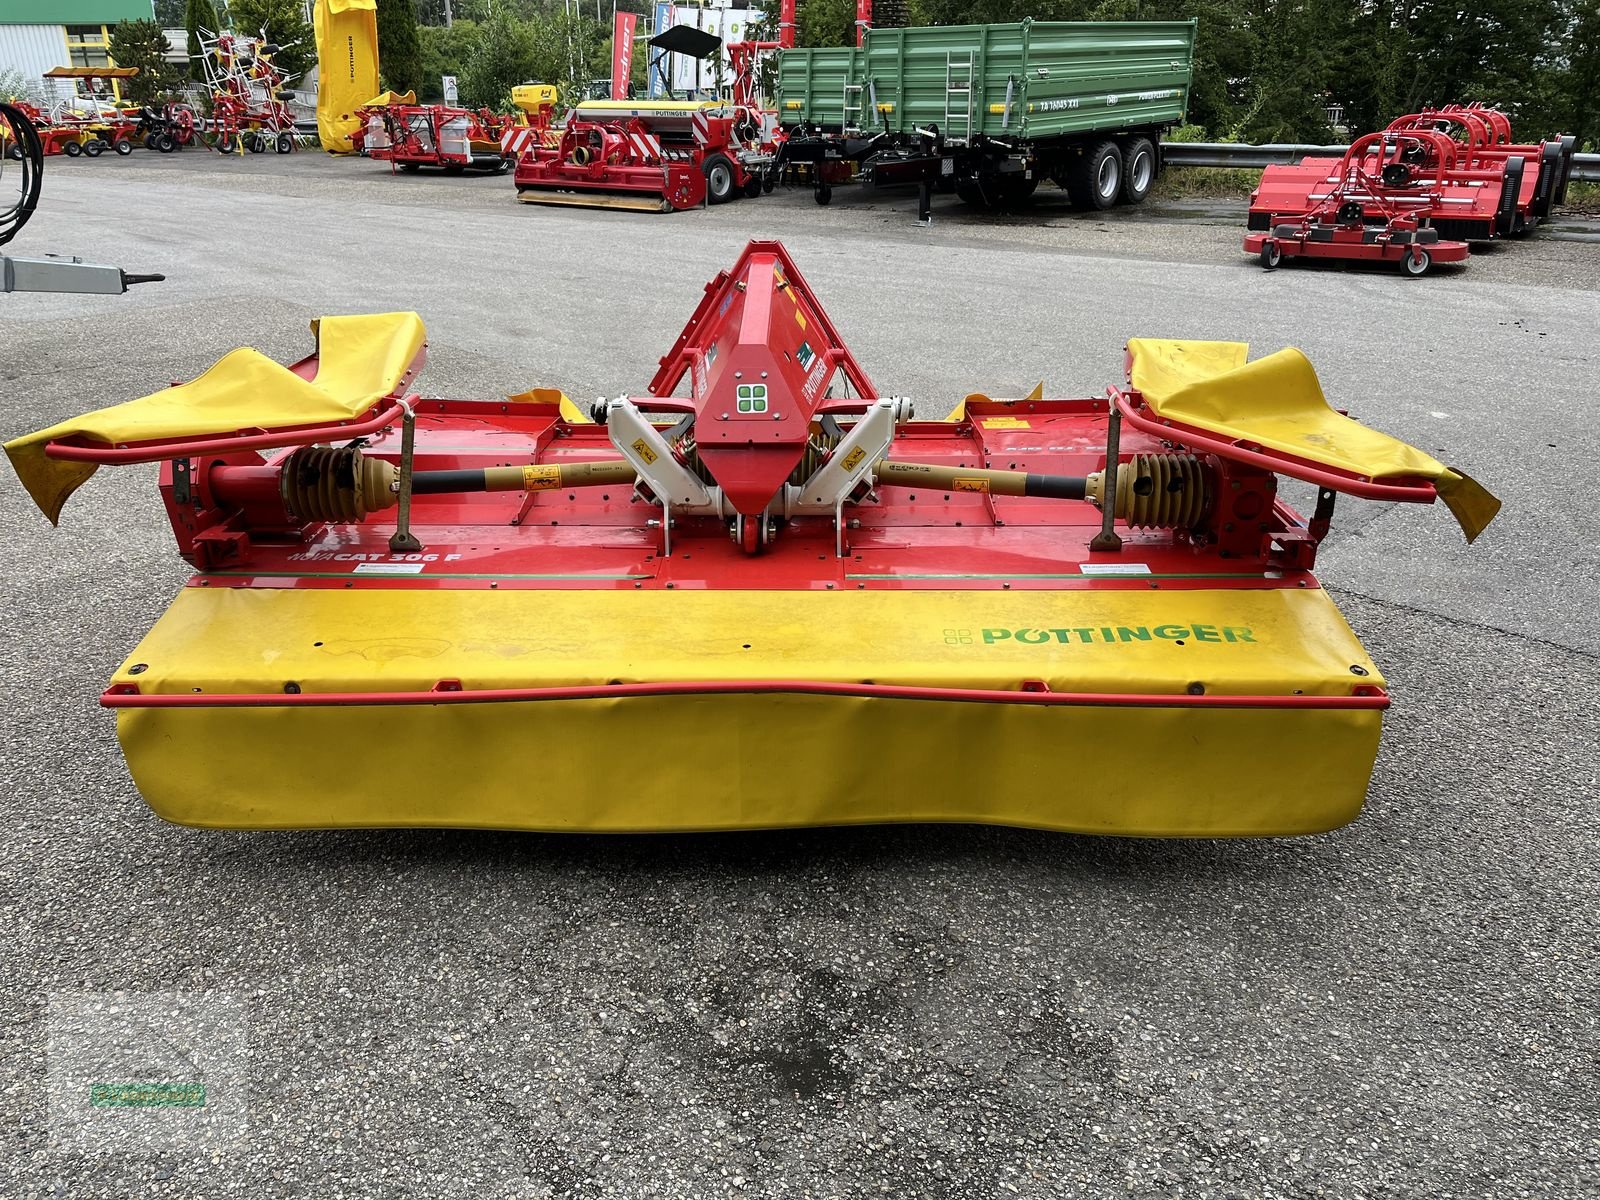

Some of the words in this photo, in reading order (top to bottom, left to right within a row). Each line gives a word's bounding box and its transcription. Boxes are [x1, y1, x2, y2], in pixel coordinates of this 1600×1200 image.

[617, 17, 630, 101] indner
[1040, 102, 1049, 111] TA
[388, 553, 440, 561] 306
[444, 553, 462, 561] F
